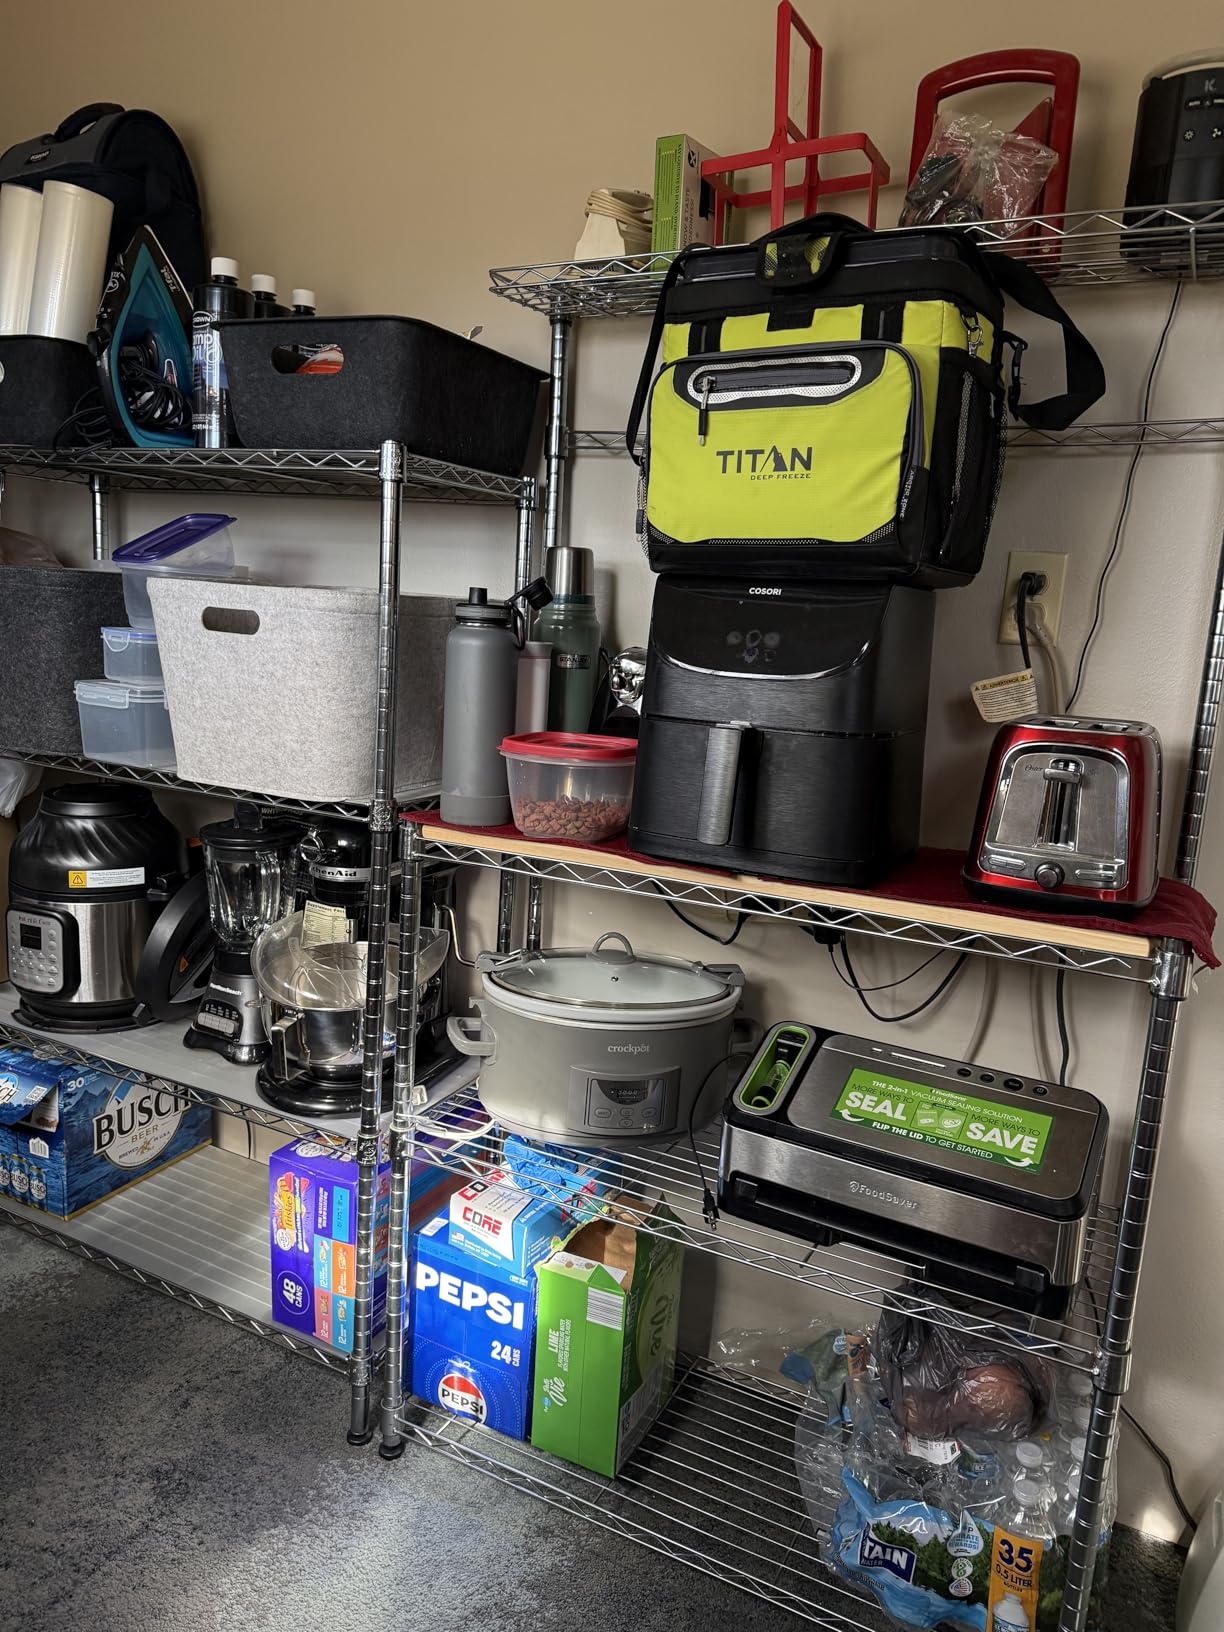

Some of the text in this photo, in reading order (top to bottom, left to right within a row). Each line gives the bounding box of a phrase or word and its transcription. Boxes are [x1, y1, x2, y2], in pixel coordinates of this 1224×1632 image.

[716, 445, 813, 474] TITAN
[748, 587, 783, 596] COSORI
[607, 1043, 650, 1055] crockpot
[67, 1077, 85, 1092] 30
[851, 1083, 914, 1104] MORE WAYS TO
[845, 1091, 907, 1121] SEAL
[872, 1080, 887, 1089] THE
[887, 1084, 909, 1094] 2-in-1
[911, 1090, 946, 1104] VACUUM
[947, 1100, 981, 1112] SEALING
[983, 1108, 1023, 1123] SOLUTION
[93, 1083, 191, 1154] BUSCH
[971, 1113, 1041, 1136] MORE WAYS TO
[131, 1125, 159, 1144] BEER
[872, 1121, 993, 1159] FLIP THE LID TO GET STARTED
[966, 1122, 1039, 1155] SAVE
[859, 1184, 918, 1209] FoodSaver
[285, 1194, 294, 1228] Friskies
[462, 1206, 503, 1236] CORE
[282, 1278, 296, 1304] 48
[295, 1285, 303, 1308] CANS
[416, 1262, 524, 1331] PEPSI
[490, 1340, 512, 1365] 24
[548, 1328, 559, 1354] LIME
[511, 1348, 520, 1368] CANS
[441, 1388, 484, 1416] PEPSI
[548, 1376, 568, 1407] Vie
[864, 1537, 908, 1570] TAIN
[998, 1538, 1034, 1573] 35
[995, 1563, 1033, 1588] 0.5 LITER
